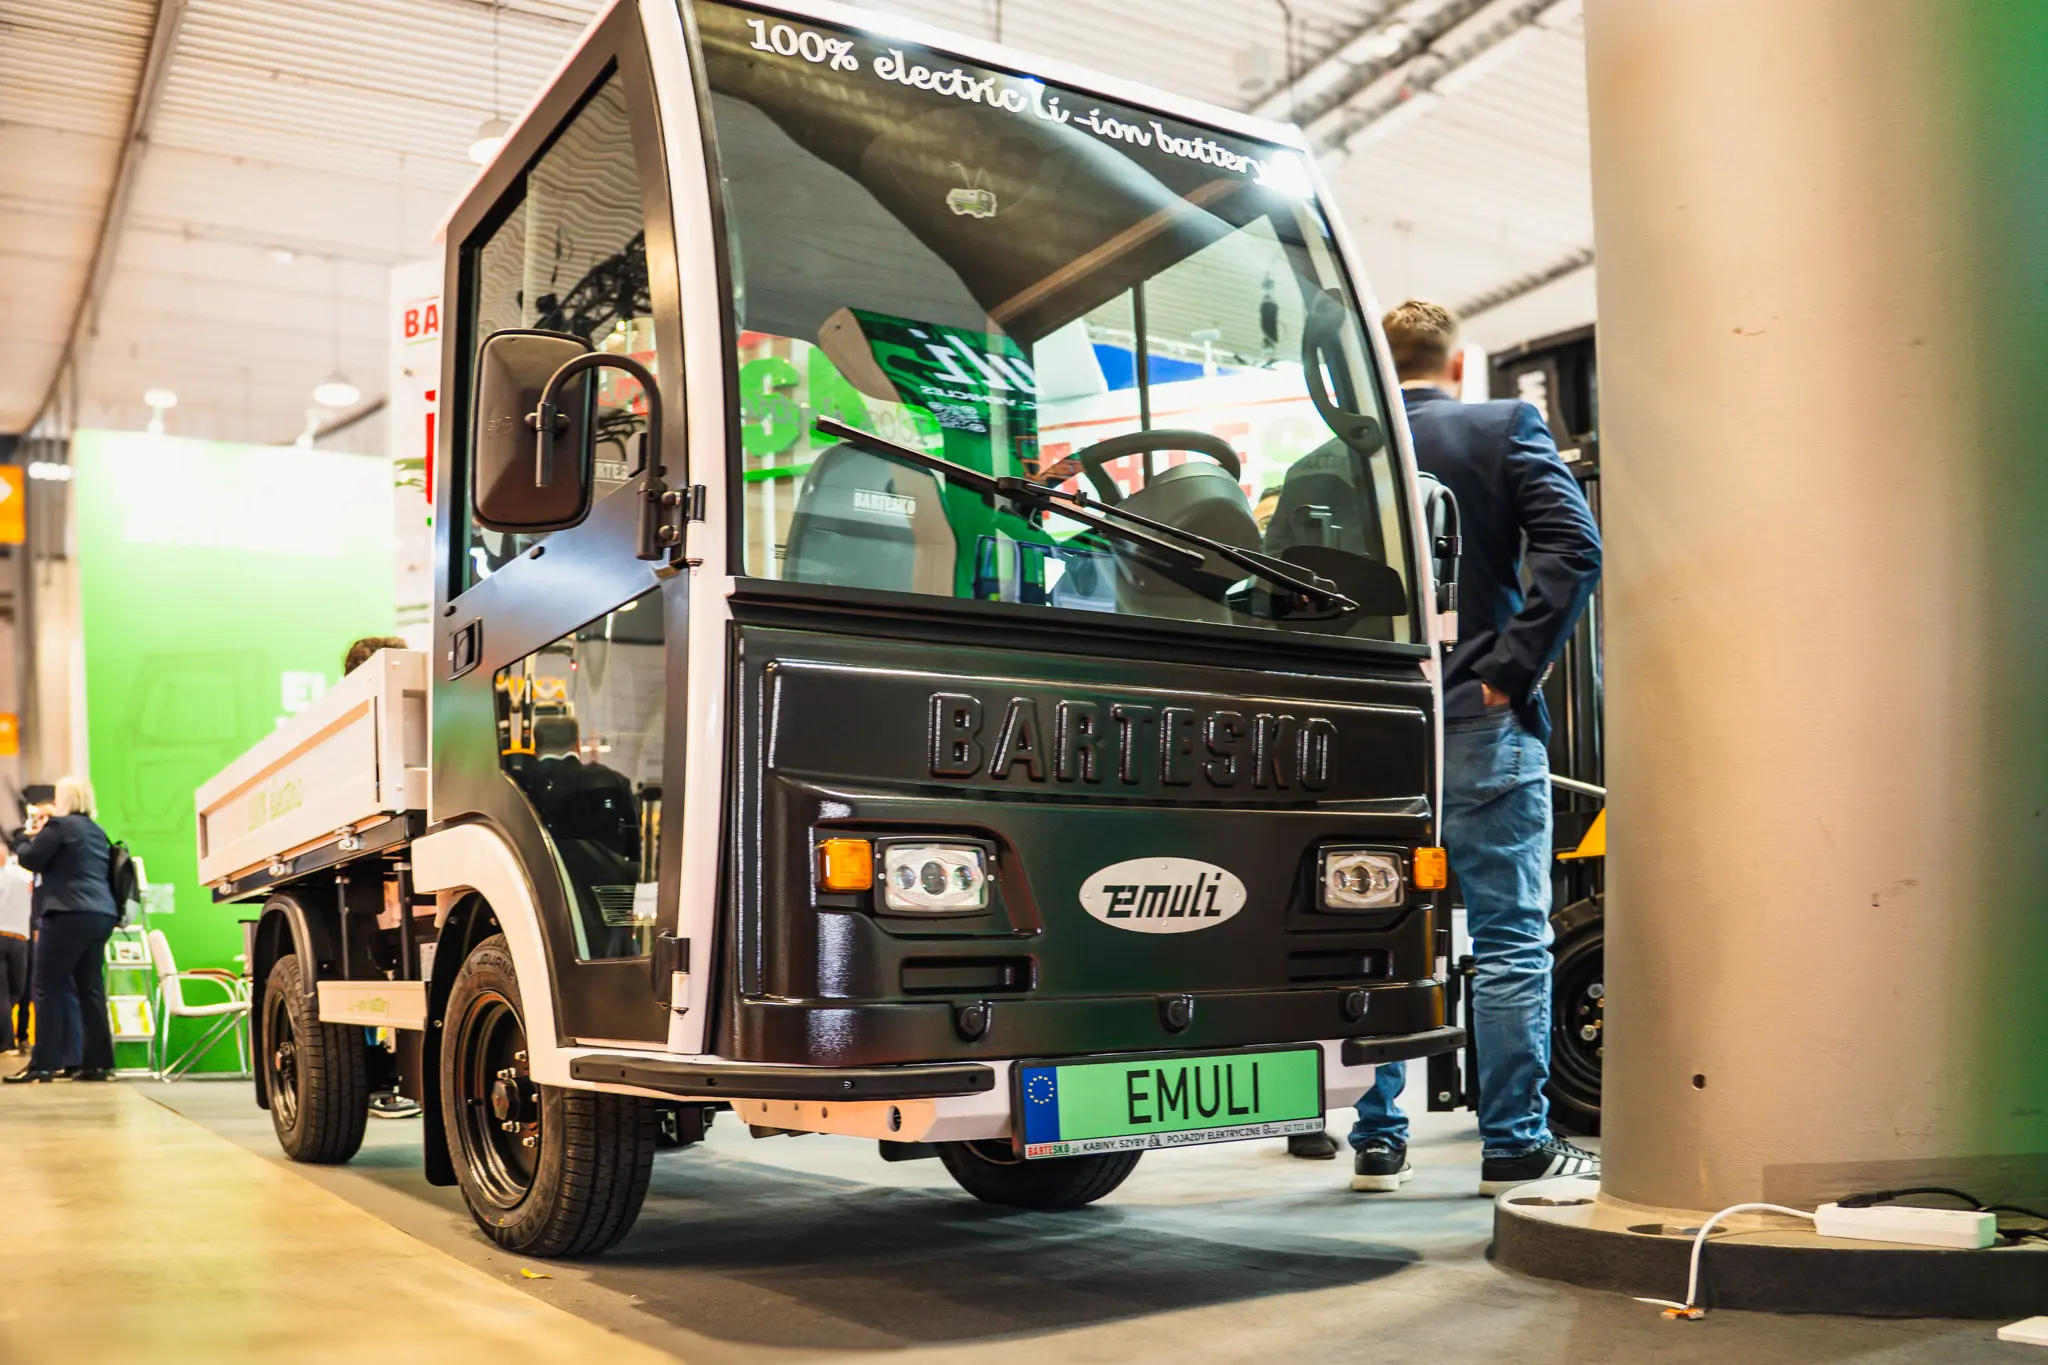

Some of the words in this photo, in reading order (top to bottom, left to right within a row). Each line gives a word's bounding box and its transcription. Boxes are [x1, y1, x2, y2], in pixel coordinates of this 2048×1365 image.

[746, 18, 859, 71] 100%
[873, 47, 1028, 113] electric
[1149, 120, 1270, 186] battery
[927, 691, 1338, 791] BARTESKO
[1126, 1061, 1260, 1125] EMULI
[1119, 1137, 1147, 1148] SZYBY
[1166, 1132, 1206, 1144] POJAZDY
[1207, 1126, 1261, 1140] ELEKTRYCZNE
